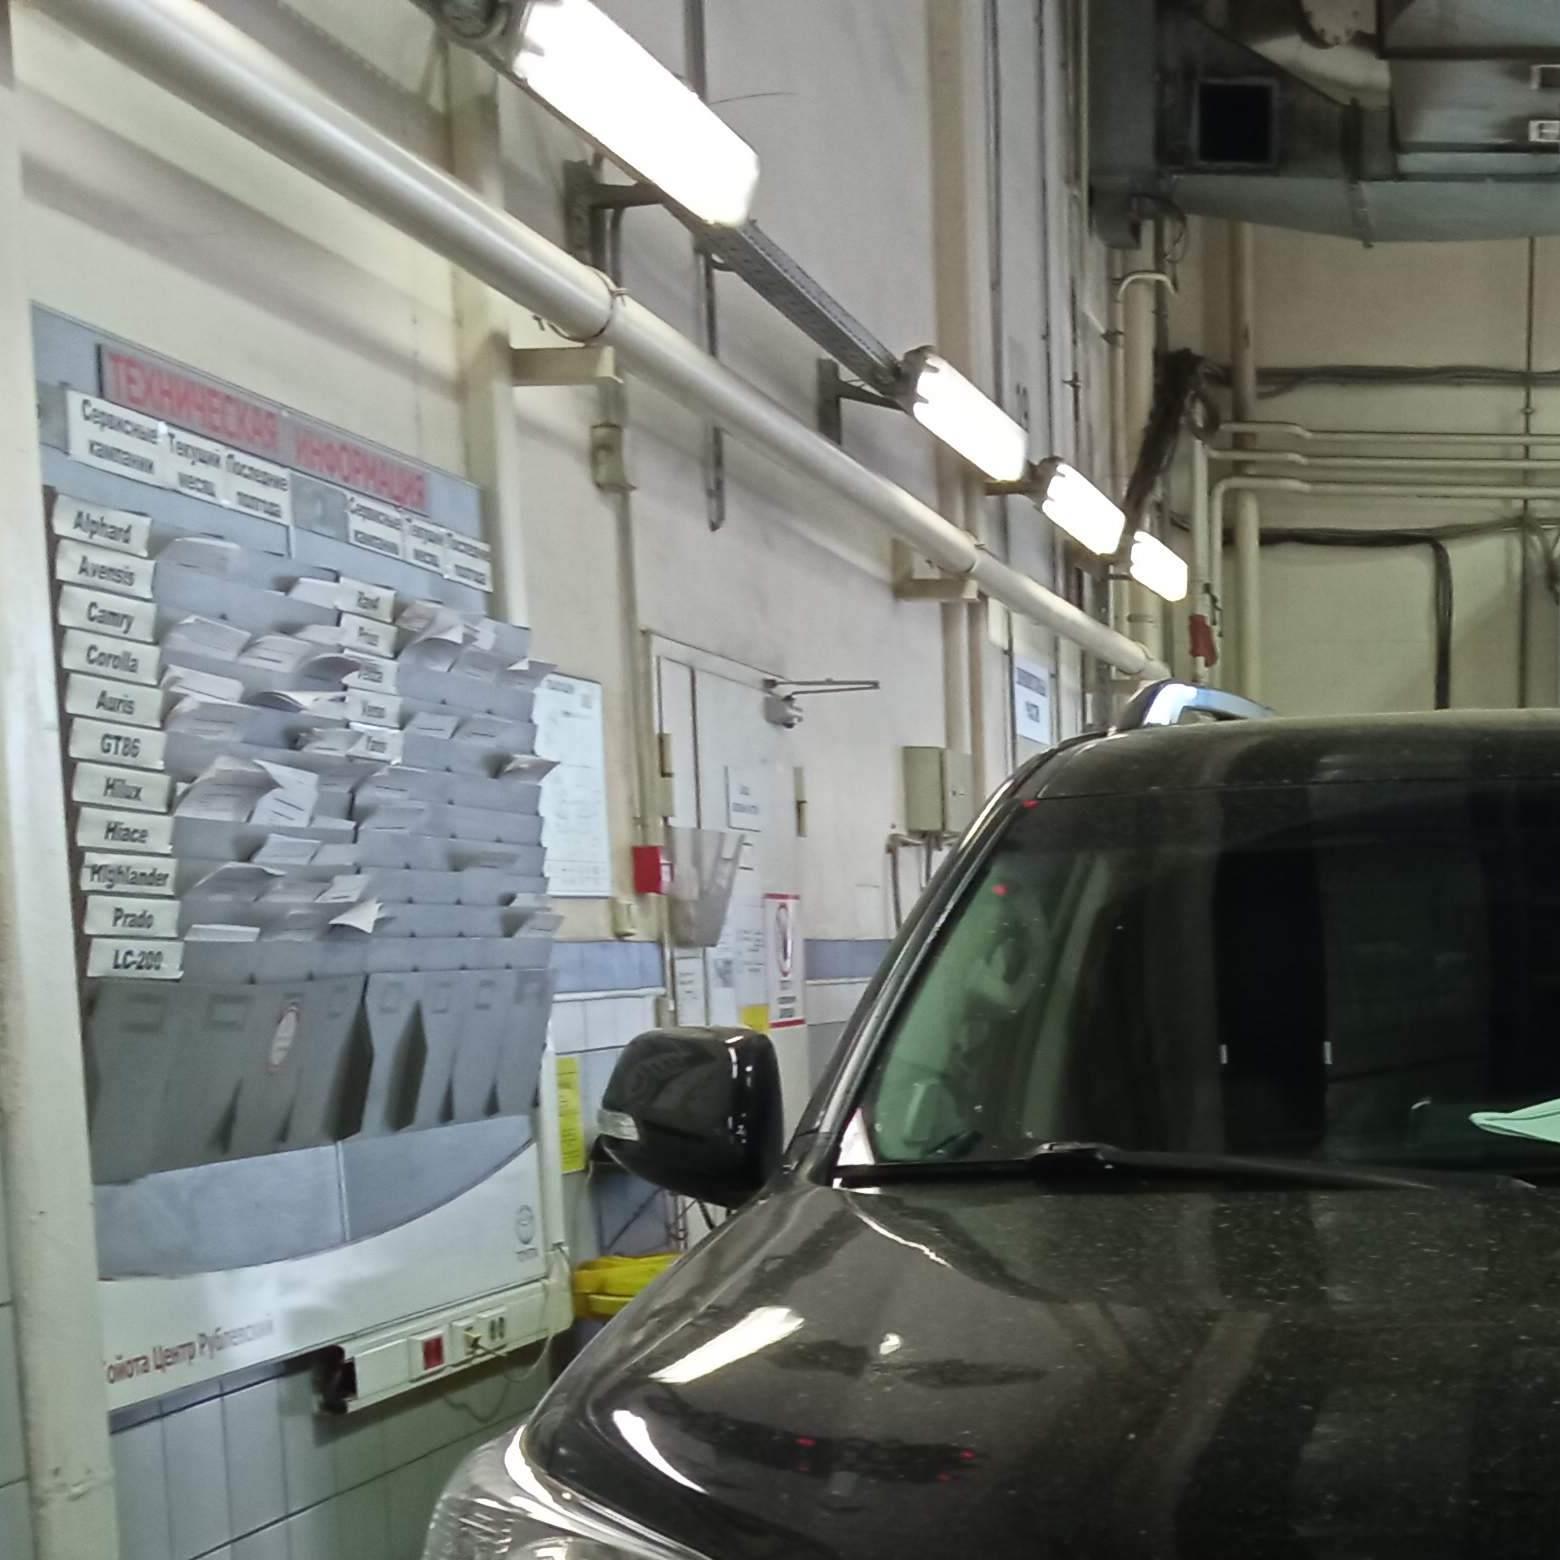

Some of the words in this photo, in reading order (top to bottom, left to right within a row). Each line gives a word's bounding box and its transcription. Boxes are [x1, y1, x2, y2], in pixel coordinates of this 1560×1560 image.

[106, 352, 281, 450] ТЕХНИЧЕСКАЯ
[295, 431, 429, 511] ИНФОРМАЦИЯ
[73, 510, 132, 544] Alphard
[78, 555, 135, 587] Avensis
[86, 601, 135, 635] Camry
[86, 644, 139, 674] Corolla
[96, 690, 135, 715] Auris
[101, 733, 140, 758] GT86
[103, 776, 143, 802] Hilux
[104, 820, 149, 844] Hiace
[89, 864, 169, 889] Highlander
[111, 907, 154, 929] Prado
[112, 949, 164, 971] LC-200
[103, 1354, 150, 1384] ойота
[152, 1341, 196, 1373] Центр
